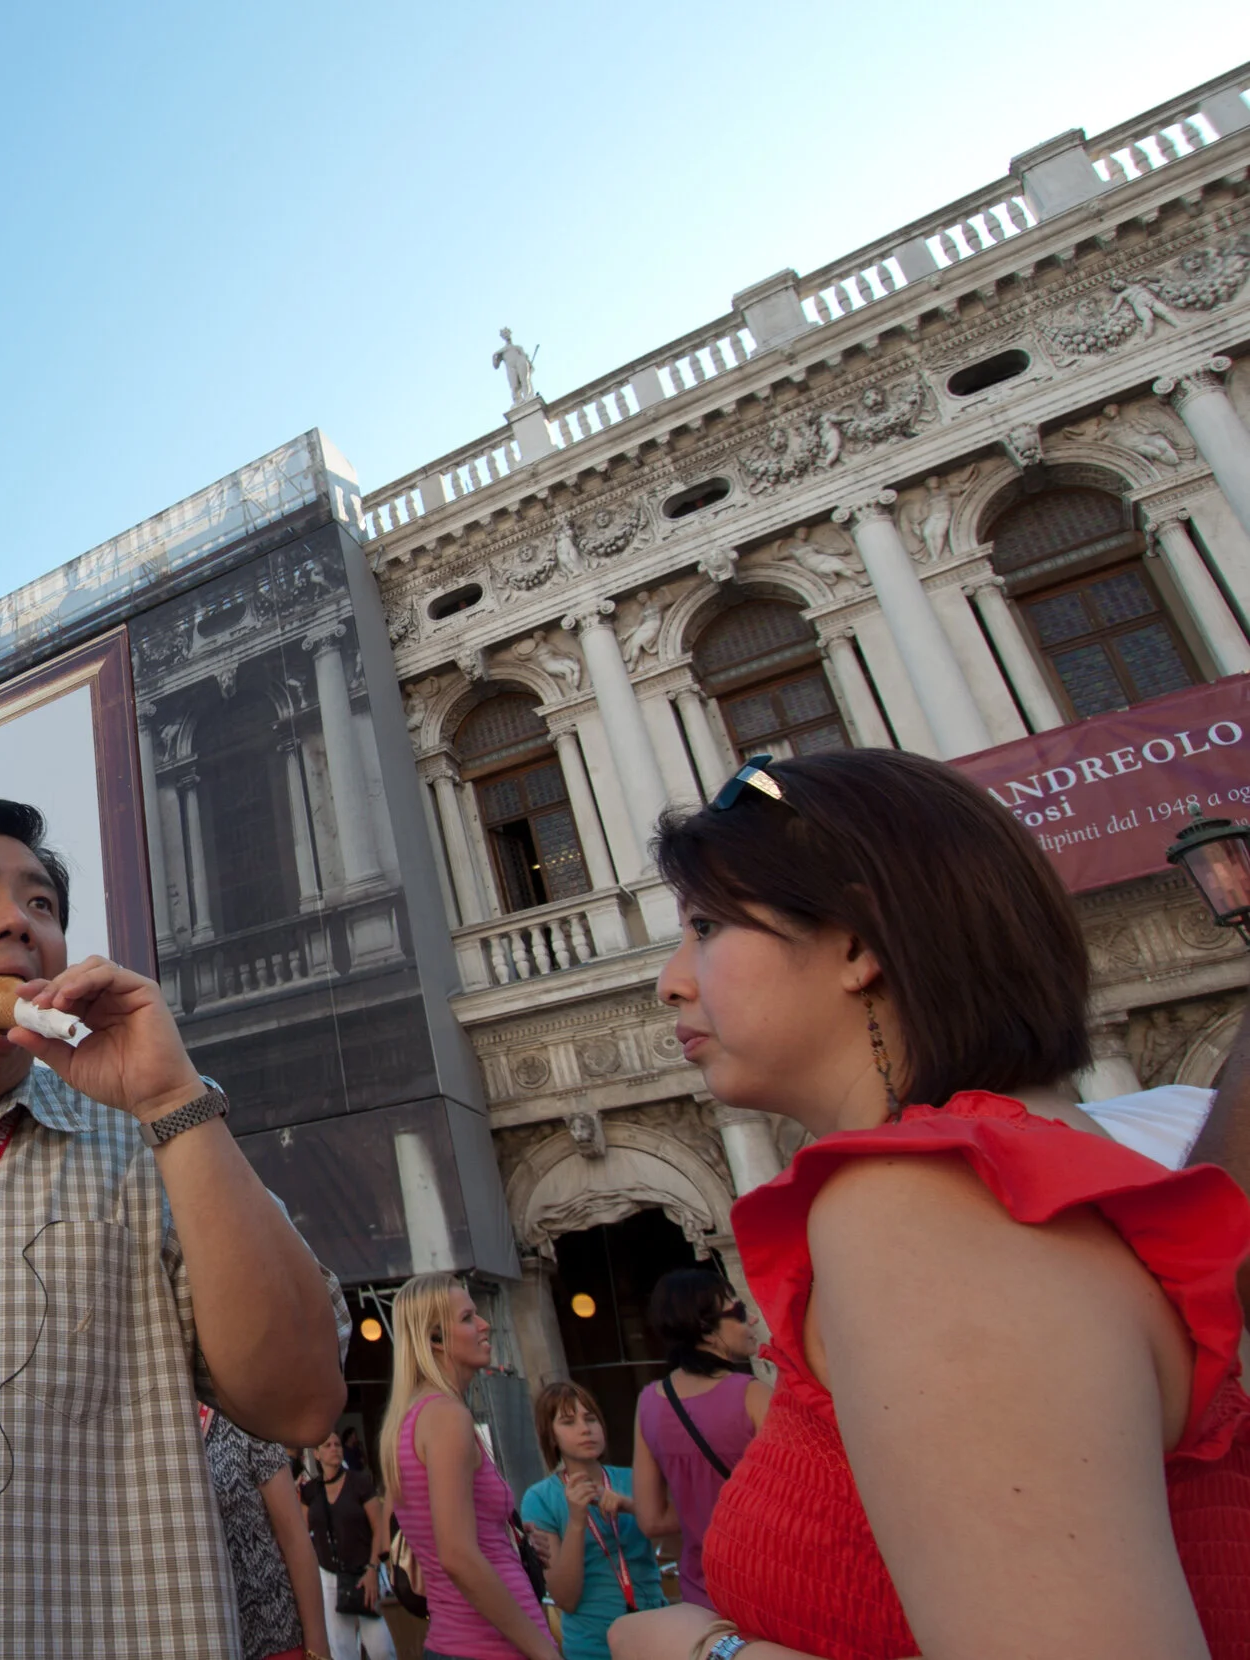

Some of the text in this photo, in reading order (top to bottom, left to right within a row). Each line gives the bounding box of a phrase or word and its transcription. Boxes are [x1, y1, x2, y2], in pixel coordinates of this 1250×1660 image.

[1106, 811, 1139, 834] dal
[1147, 794, 1200, 822] 1948
[1207, 792, 1222, 807] a
